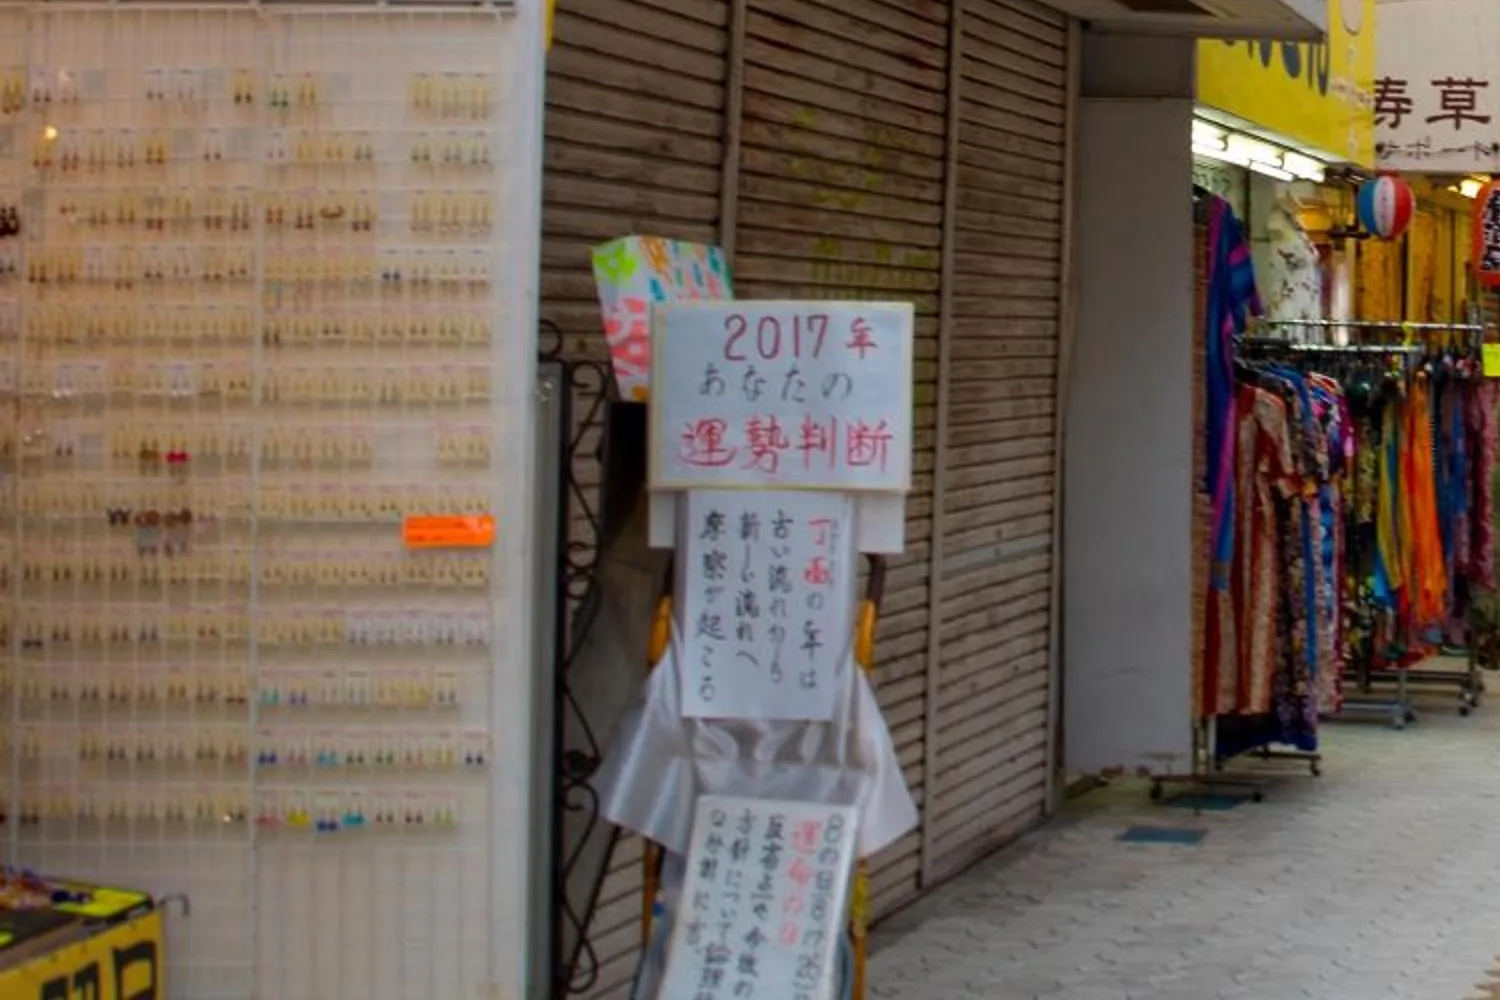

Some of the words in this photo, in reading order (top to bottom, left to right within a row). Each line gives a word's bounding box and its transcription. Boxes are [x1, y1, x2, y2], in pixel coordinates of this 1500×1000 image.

[723, 313, 878, 362] 2017年
[699, 363, 852, 402] あなたの
[678, 414, 894, 475] 運勢判断
